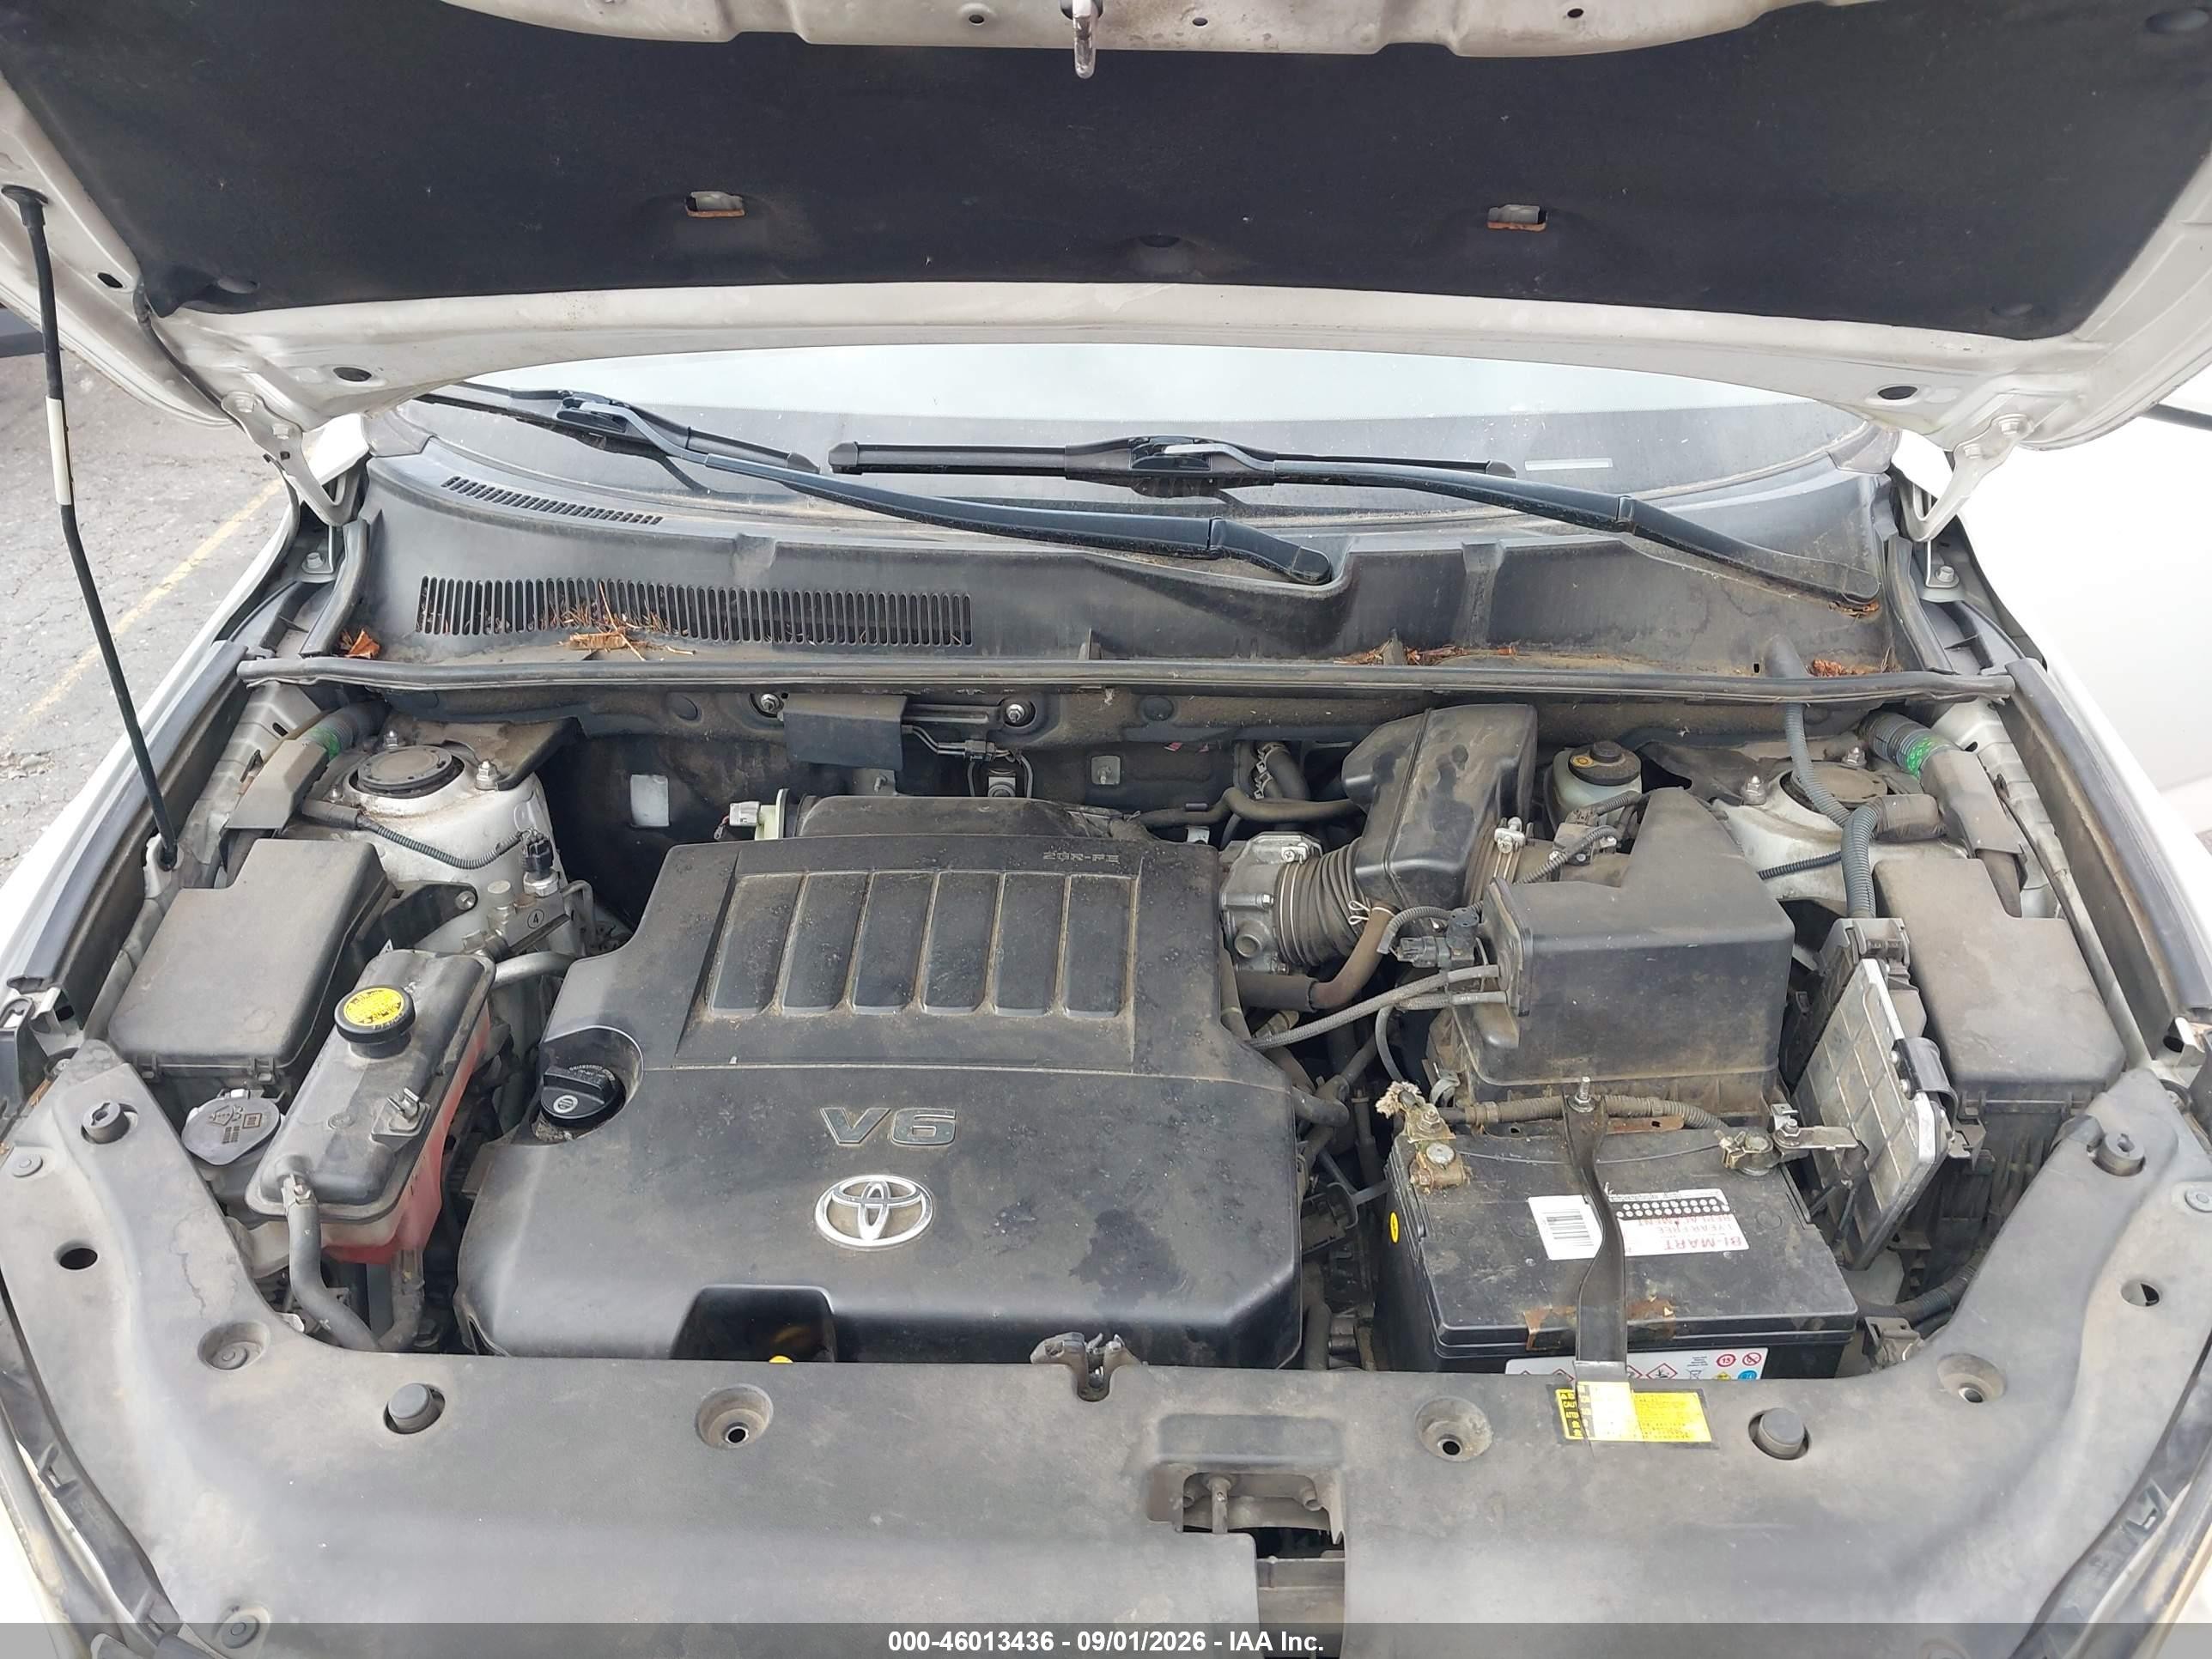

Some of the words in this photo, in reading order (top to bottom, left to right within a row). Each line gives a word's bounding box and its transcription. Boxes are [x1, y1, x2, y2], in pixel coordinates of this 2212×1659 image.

[819, 1107, 957, 1146] V6
[1656, 1225, 1688, 1234] FREE
[1692, 1224, 1726, 1232] YEAR
[1664, 1236, 1741, 1251] BI-MART
